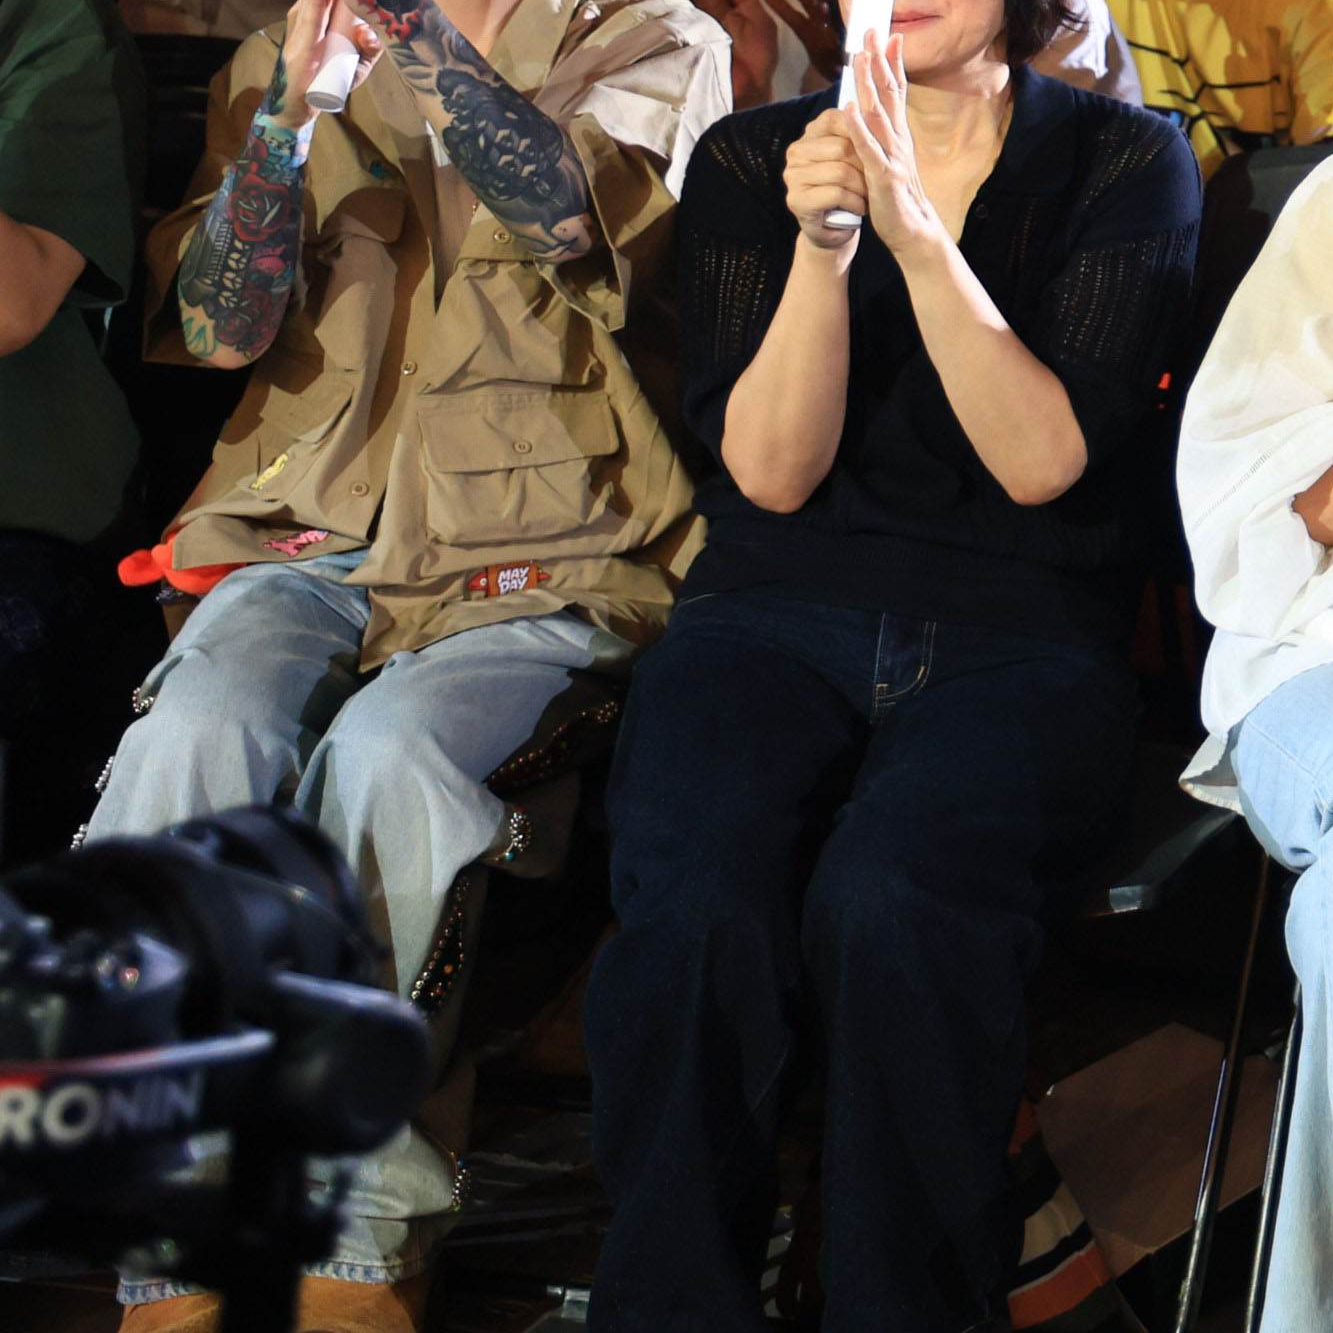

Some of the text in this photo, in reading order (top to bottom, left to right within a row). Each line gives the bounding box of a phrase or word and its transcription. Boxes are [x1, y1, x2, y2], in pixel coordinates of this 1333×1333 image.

[498, 566, 530, 582] MAY
[498, 577, 529, 595] DAY
[0, 1072, 204, 1144] RONIN
